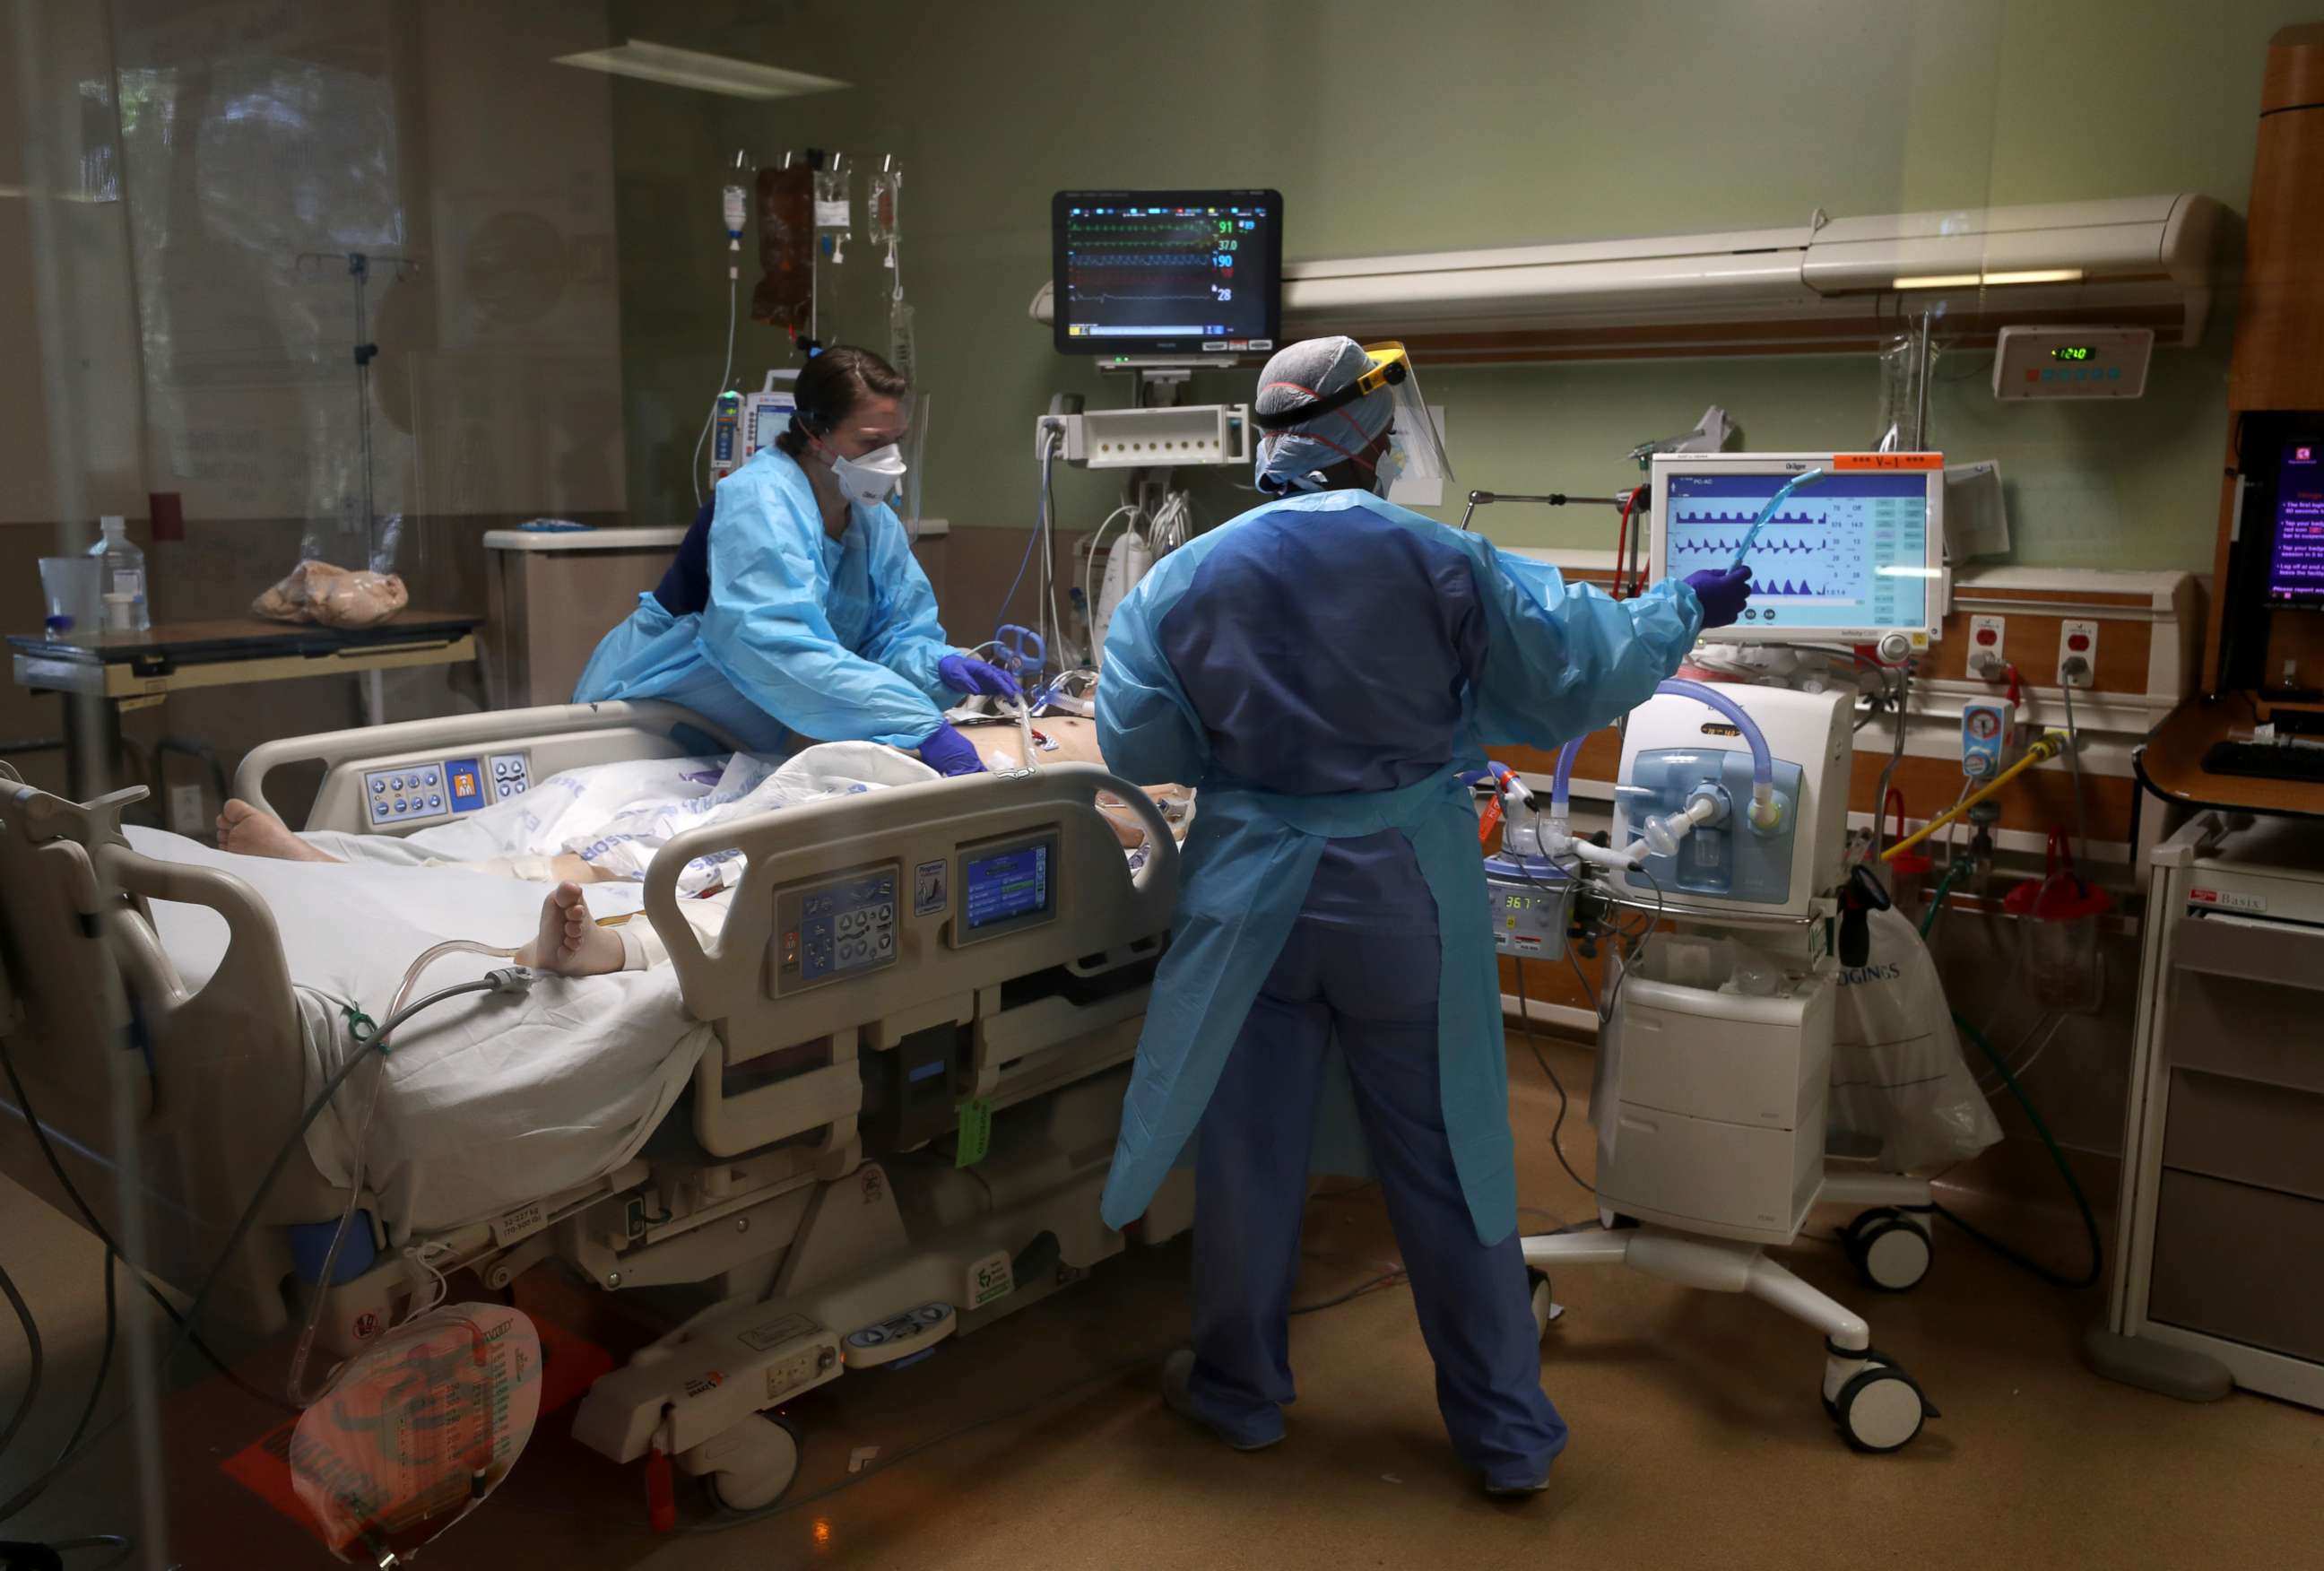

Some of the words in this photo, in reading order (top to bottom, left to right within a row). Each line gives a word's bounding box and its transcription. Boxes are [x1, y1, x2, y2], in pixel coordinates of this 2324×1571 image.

[1218, 221, 1233, 233] 91
[1218, 239, 1238, 250] 37.0
[1218, 255, 1233, 267] 90
[1218, 288, 1232, 301] 28
[2221, 893, 2259, 908] Basix
